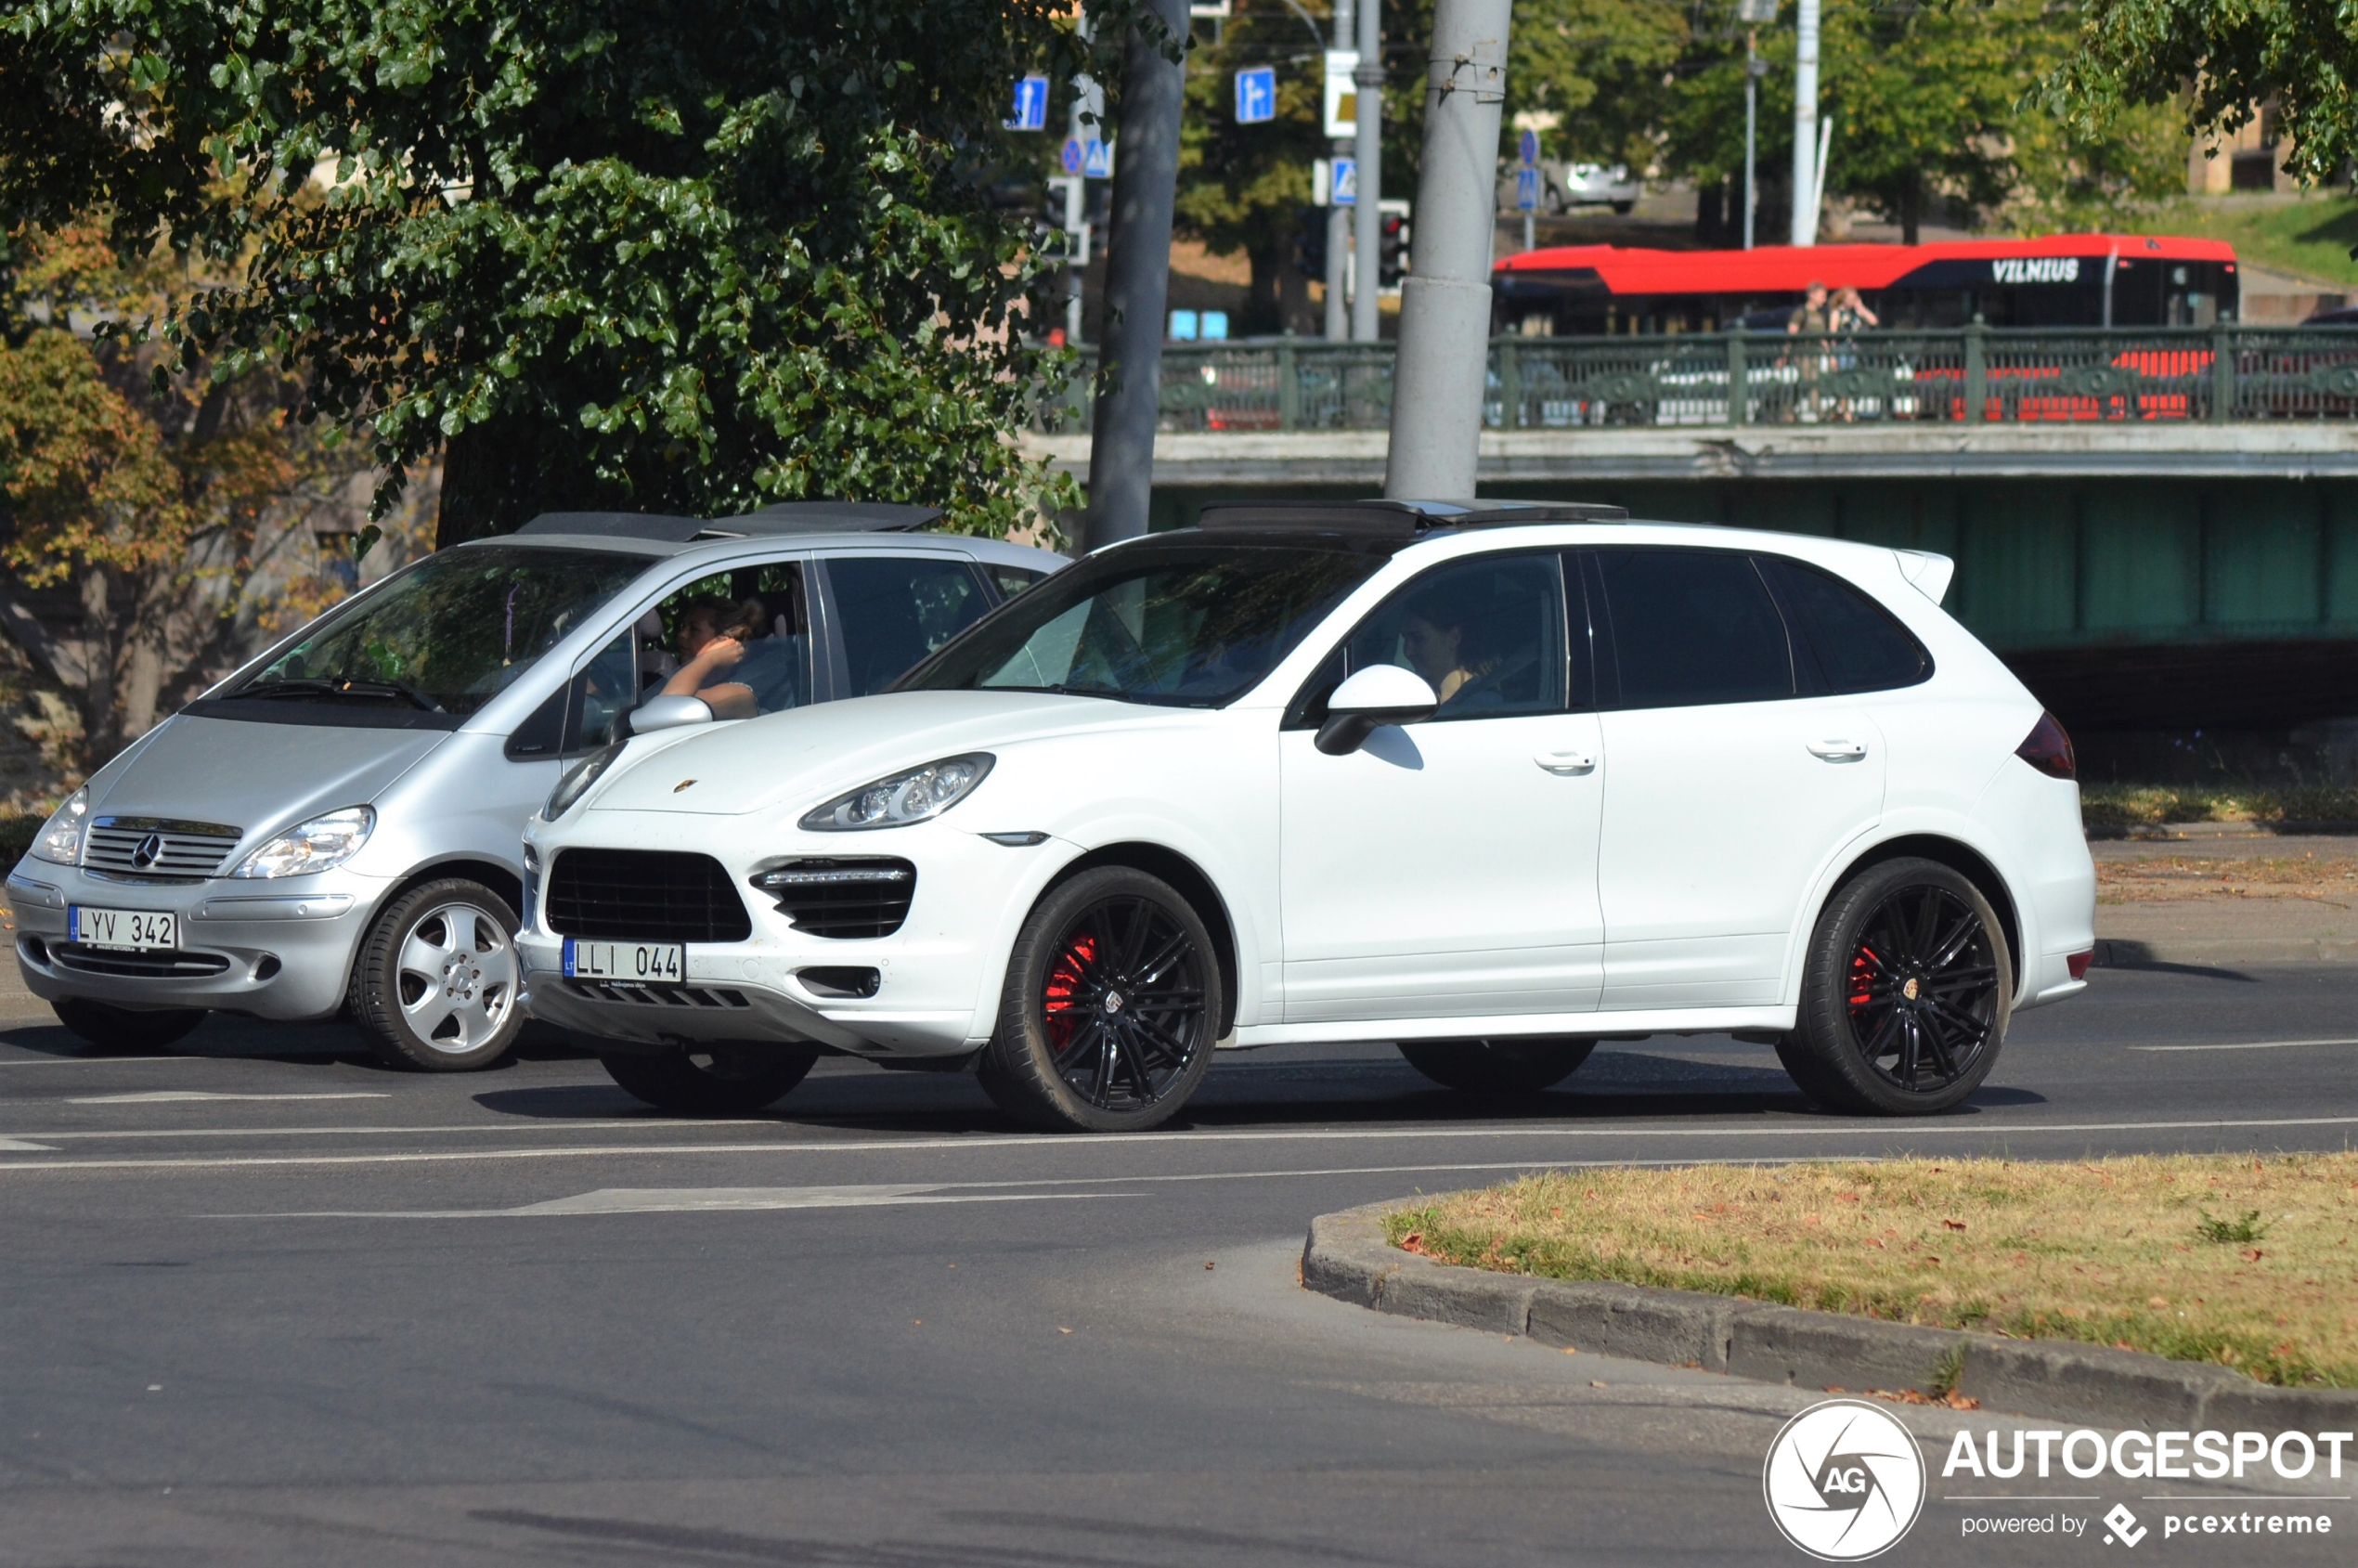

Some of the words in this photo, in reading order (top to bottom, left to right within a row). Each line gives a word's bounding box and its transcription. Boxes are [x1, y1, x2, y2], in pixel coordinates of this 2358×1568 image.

[1993, 258, 2079, 283] VILNIUS
[79, 911, 116, 940] LYV
[131, 914, 171, 944] 342
[565, 961, 574, 970] LT
[577, 943, 615, 975] LLI
[636, 946, 678, 978] 044
